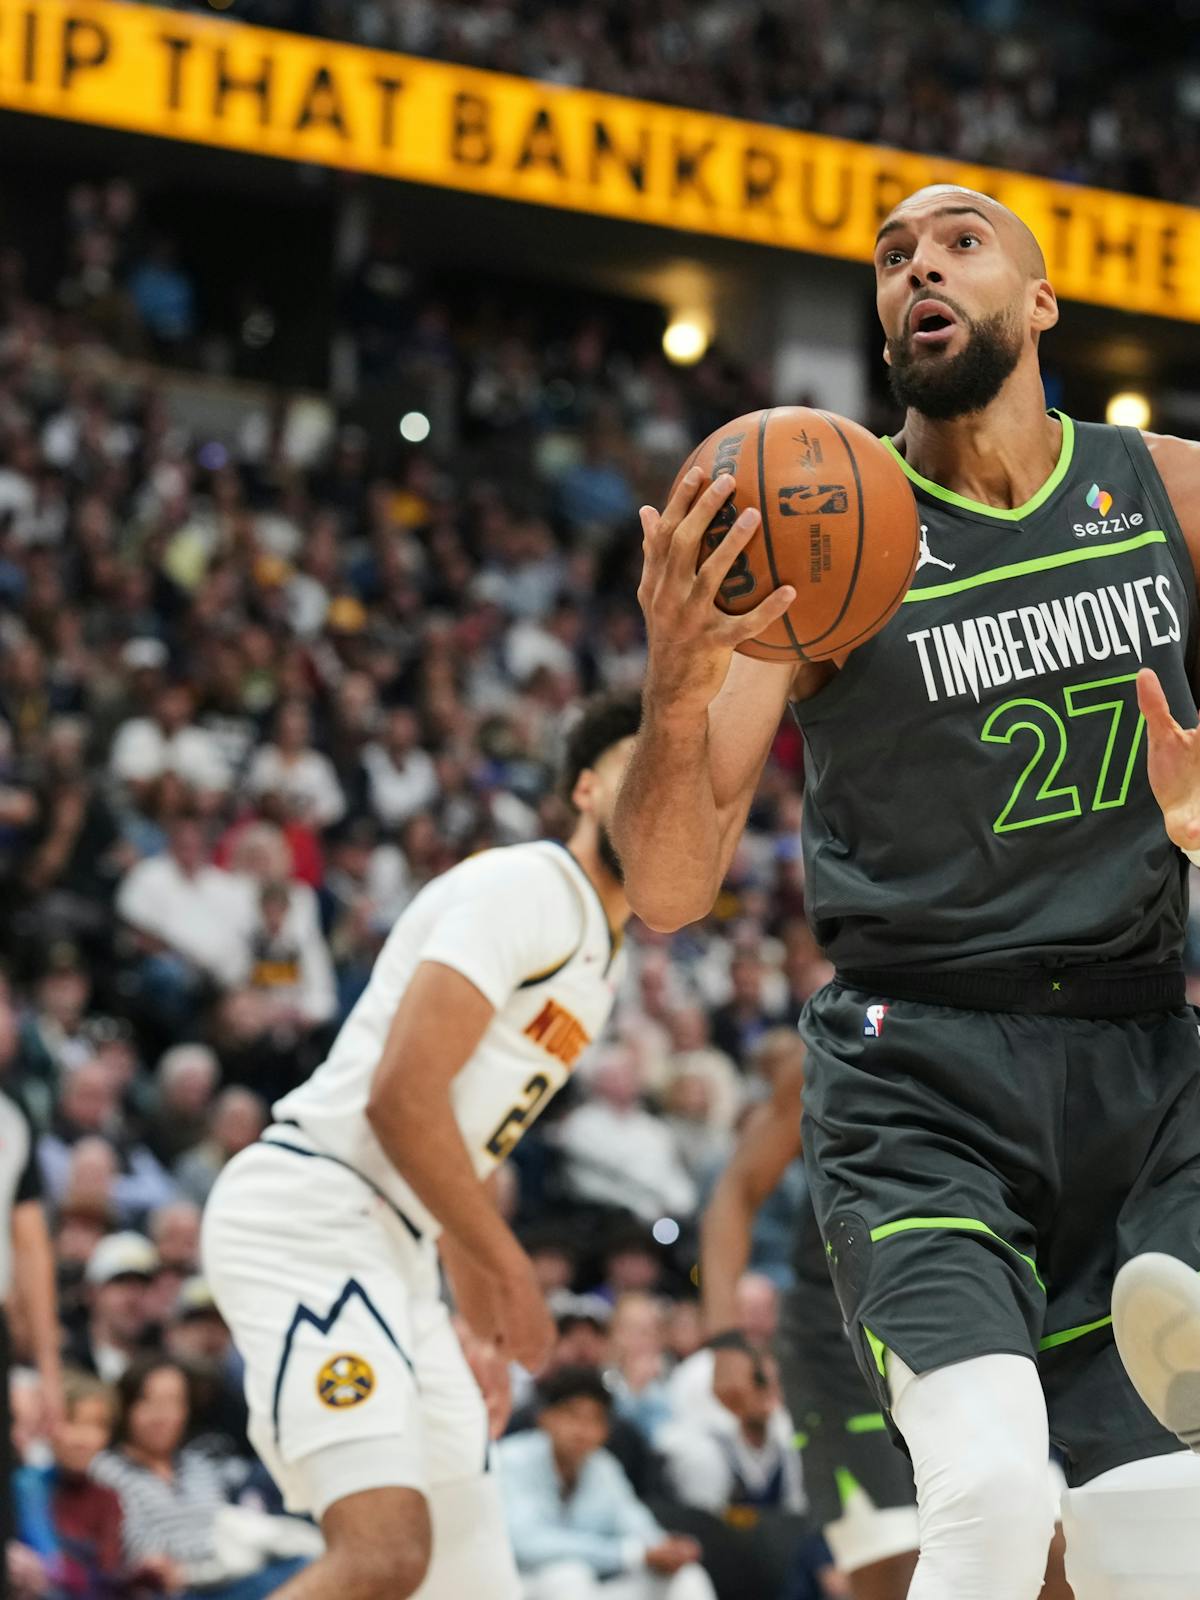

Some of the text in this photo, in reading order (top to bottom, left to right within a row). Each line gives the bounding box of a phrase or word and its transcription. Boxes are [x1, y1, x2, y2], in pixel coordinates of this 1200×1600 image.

[159, 33, 404, 150] THAT
[1052, 205, 1180, 295] THE
[1072, 512, 1144, 538] sezzle
[906, 574, 1182, 704] TIMBERWOLVES
[980, 672, 1146, 834] 27
